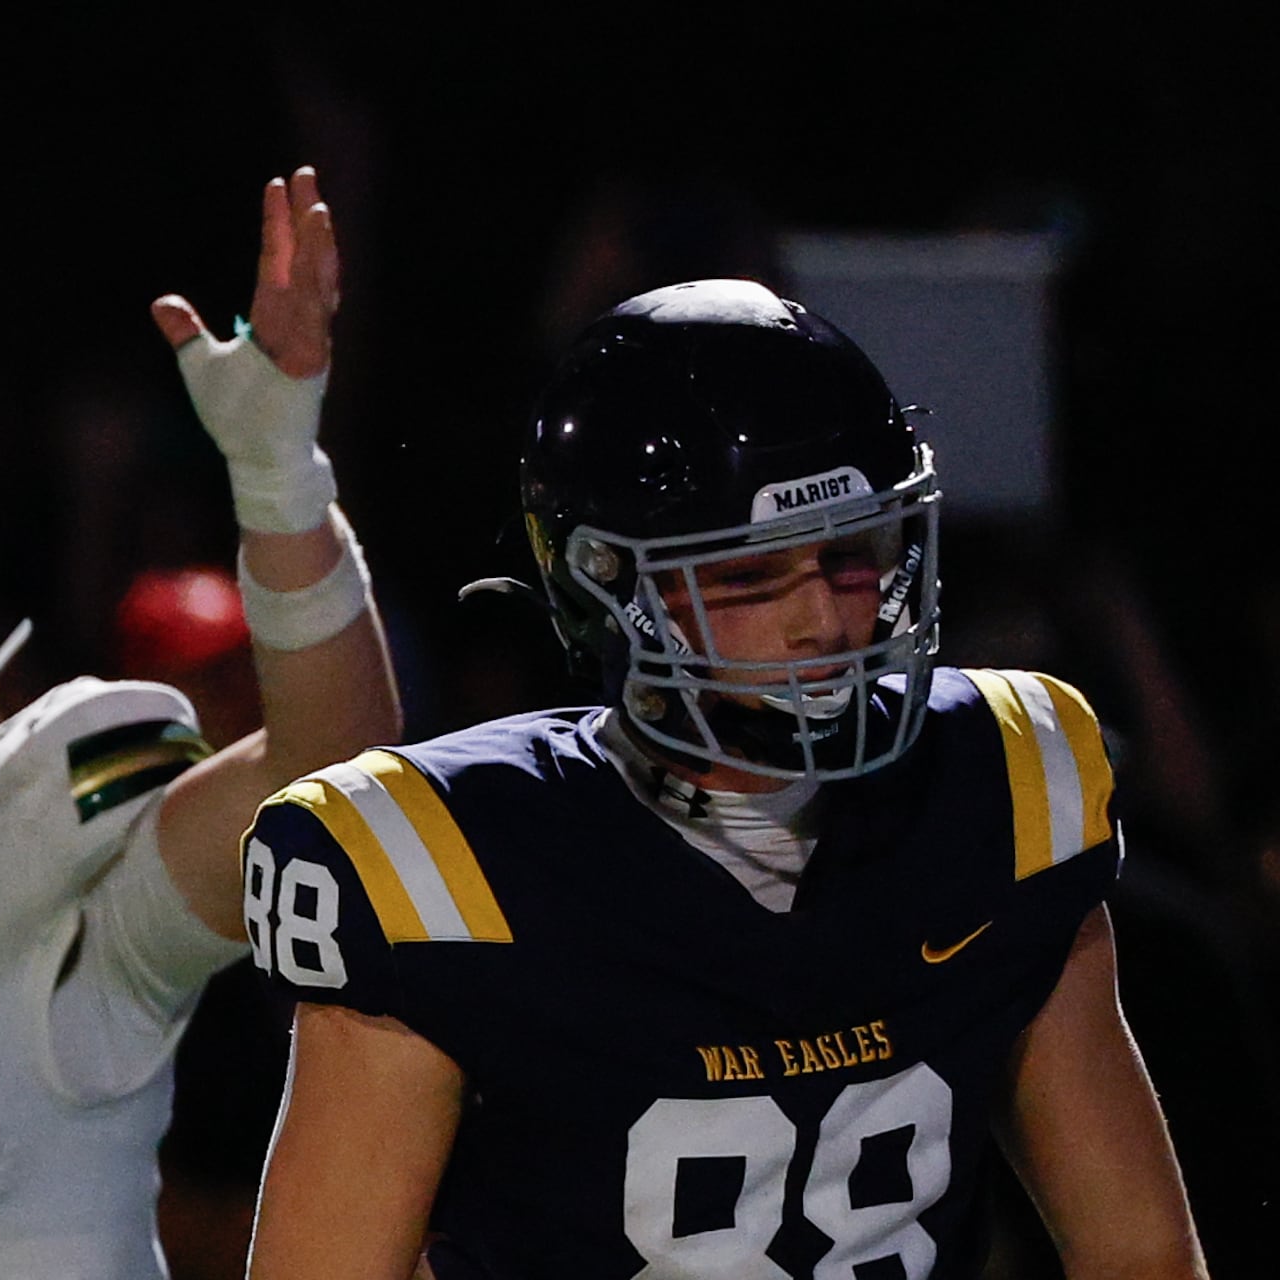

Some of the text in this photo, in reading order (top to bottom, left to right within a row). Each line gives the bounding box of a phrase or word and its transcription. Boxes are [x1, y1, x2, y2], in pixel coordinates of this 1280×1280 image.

[773, 474, 852, 513] MARIST
[243, 834, 349, 990] 88
[696, 1018, 894, 1082] WAR EAGLES
